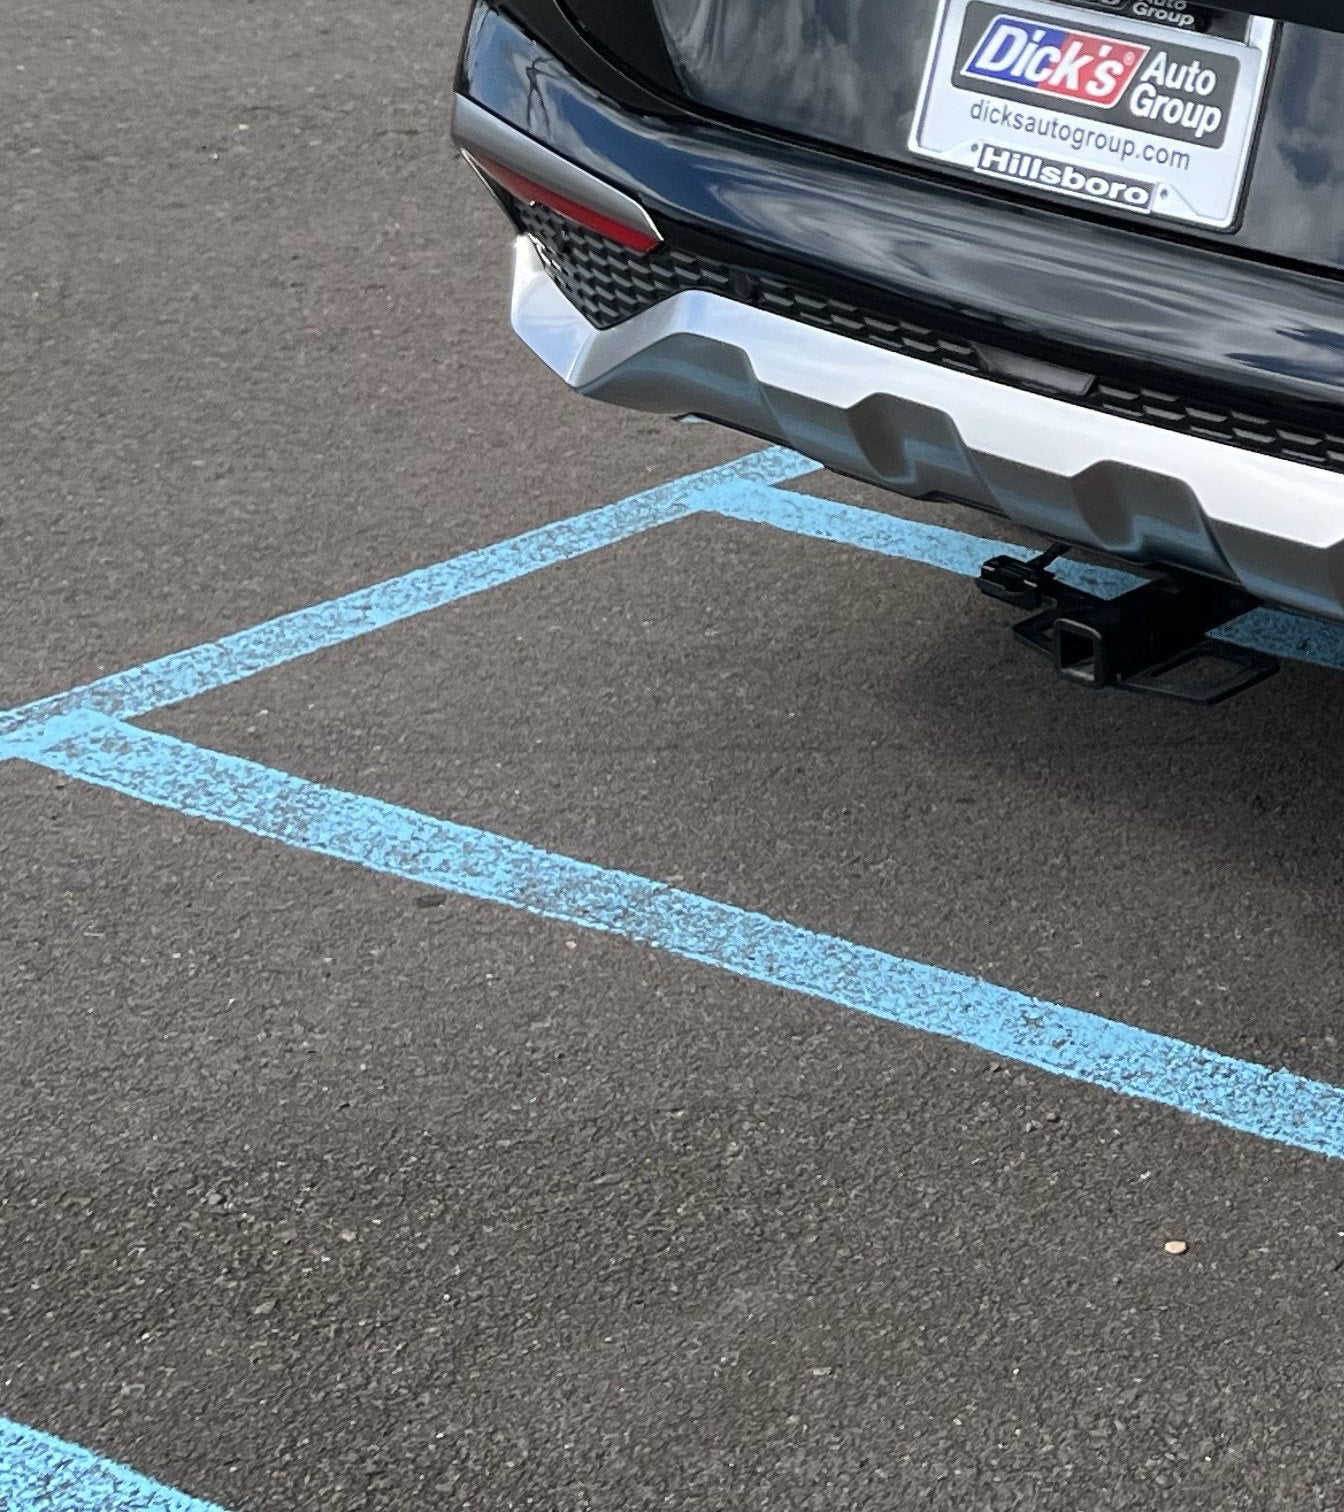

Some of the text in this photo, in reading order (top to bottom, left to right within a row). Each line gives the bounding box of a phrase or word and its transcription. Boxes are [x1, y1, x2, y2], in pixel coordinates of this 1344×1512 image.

[1132, 1, 1195, 26] Group
[1140, 51, 1218, 96] Auto
[969, 99, 1191, 171] dicksautogroup.com
[1129, 82, 1222, 138] Group
[980, 145, 1150, 205] Hillsboro
